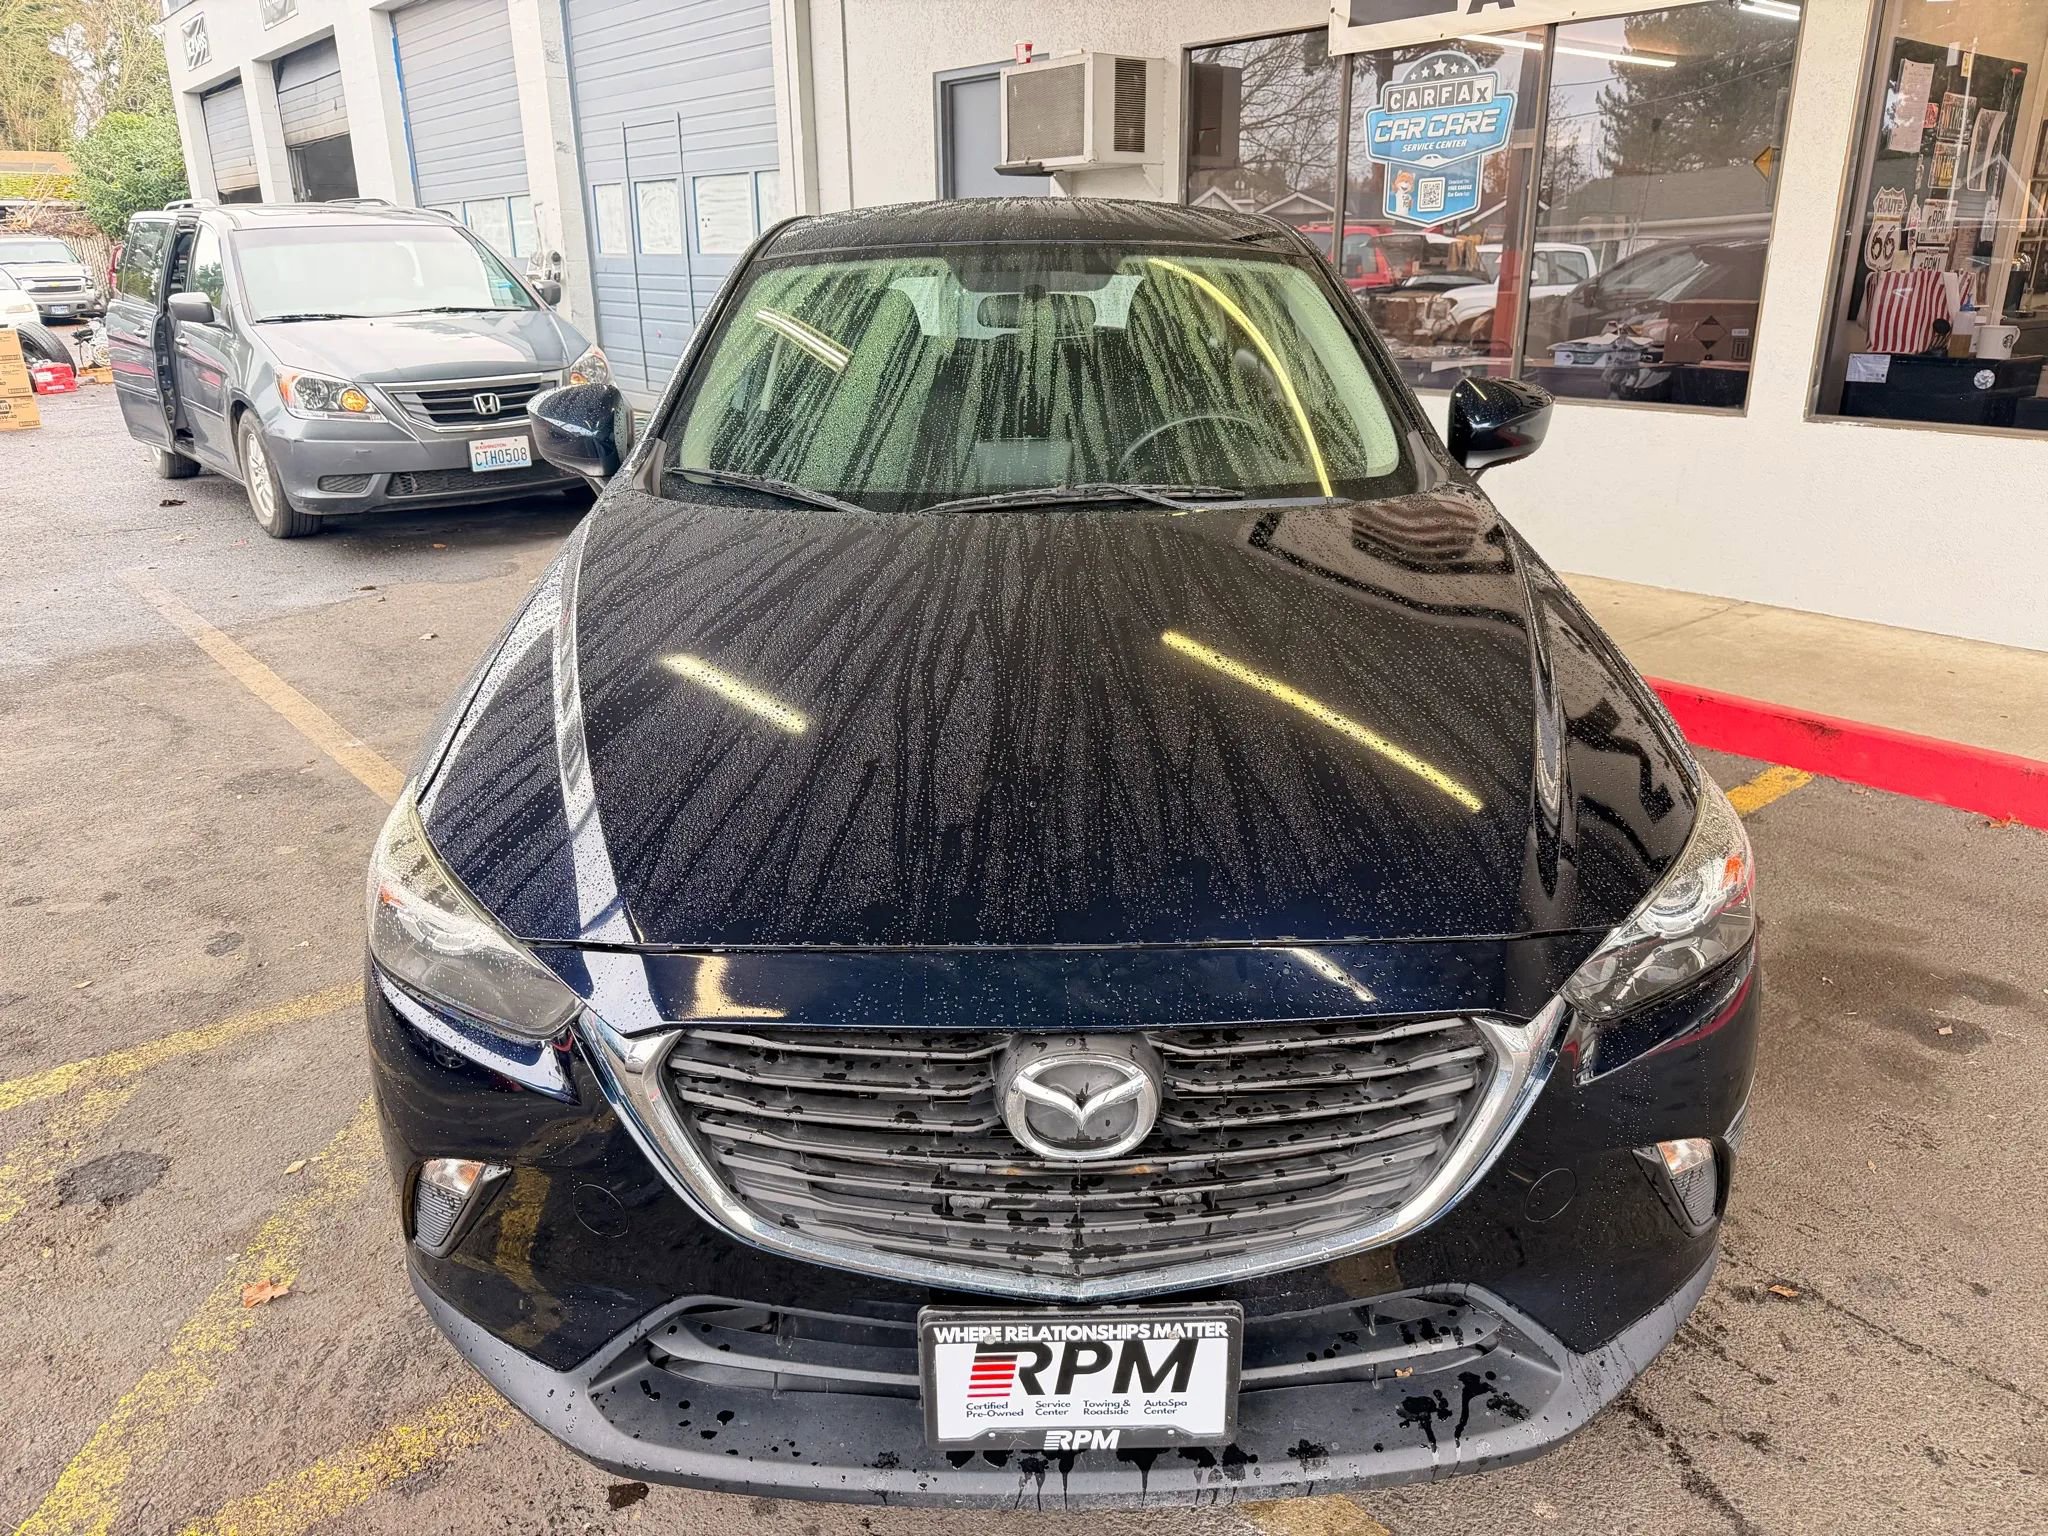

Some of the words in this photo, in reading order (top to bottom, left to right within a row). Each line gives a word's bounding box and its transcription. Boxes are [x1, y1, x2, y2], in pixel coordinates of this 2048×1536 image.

[1389, 84, 1489, 110] CARFAX
[1374, 116, 1426, 143] CAR
[1427, 108, 1501, 138] CARE
[1401, 142, 1434, 153] SERVICE
[1435, 139, 1468, 150] CENTER
[1877, 197, 1903, 213] ROUTE
[1870, 224, 1896, 261] 66
[475, 447, 528, 466] CTH0508
[933, 1326, 1001, 1344] WHERE
[1004, 1323, 1151, 1342] RELATIONSHIPS
[1153, 1321, 1229, 1339] MATTER
[967, 1338, 1199, 1397] RPM
[966, 1401, 1009, 1411] Certified
[1035, 1400, 1071, 1409] Service
[1083, 1399, 1121, 1410] Towing
[1122, 1399, 1131, 1408] &
[1143, 1398, 1188, 1408] AutoSpa
[966, 1409, 1024, 1418] Pre-Owned
[1035, 1408, 1069, 1416] Center
[1083, 1407, 1129, 1415] Roadside
[1143, 1406, 1178, 1415] Center
[1043, 1429, 1121, 1451] RPM
